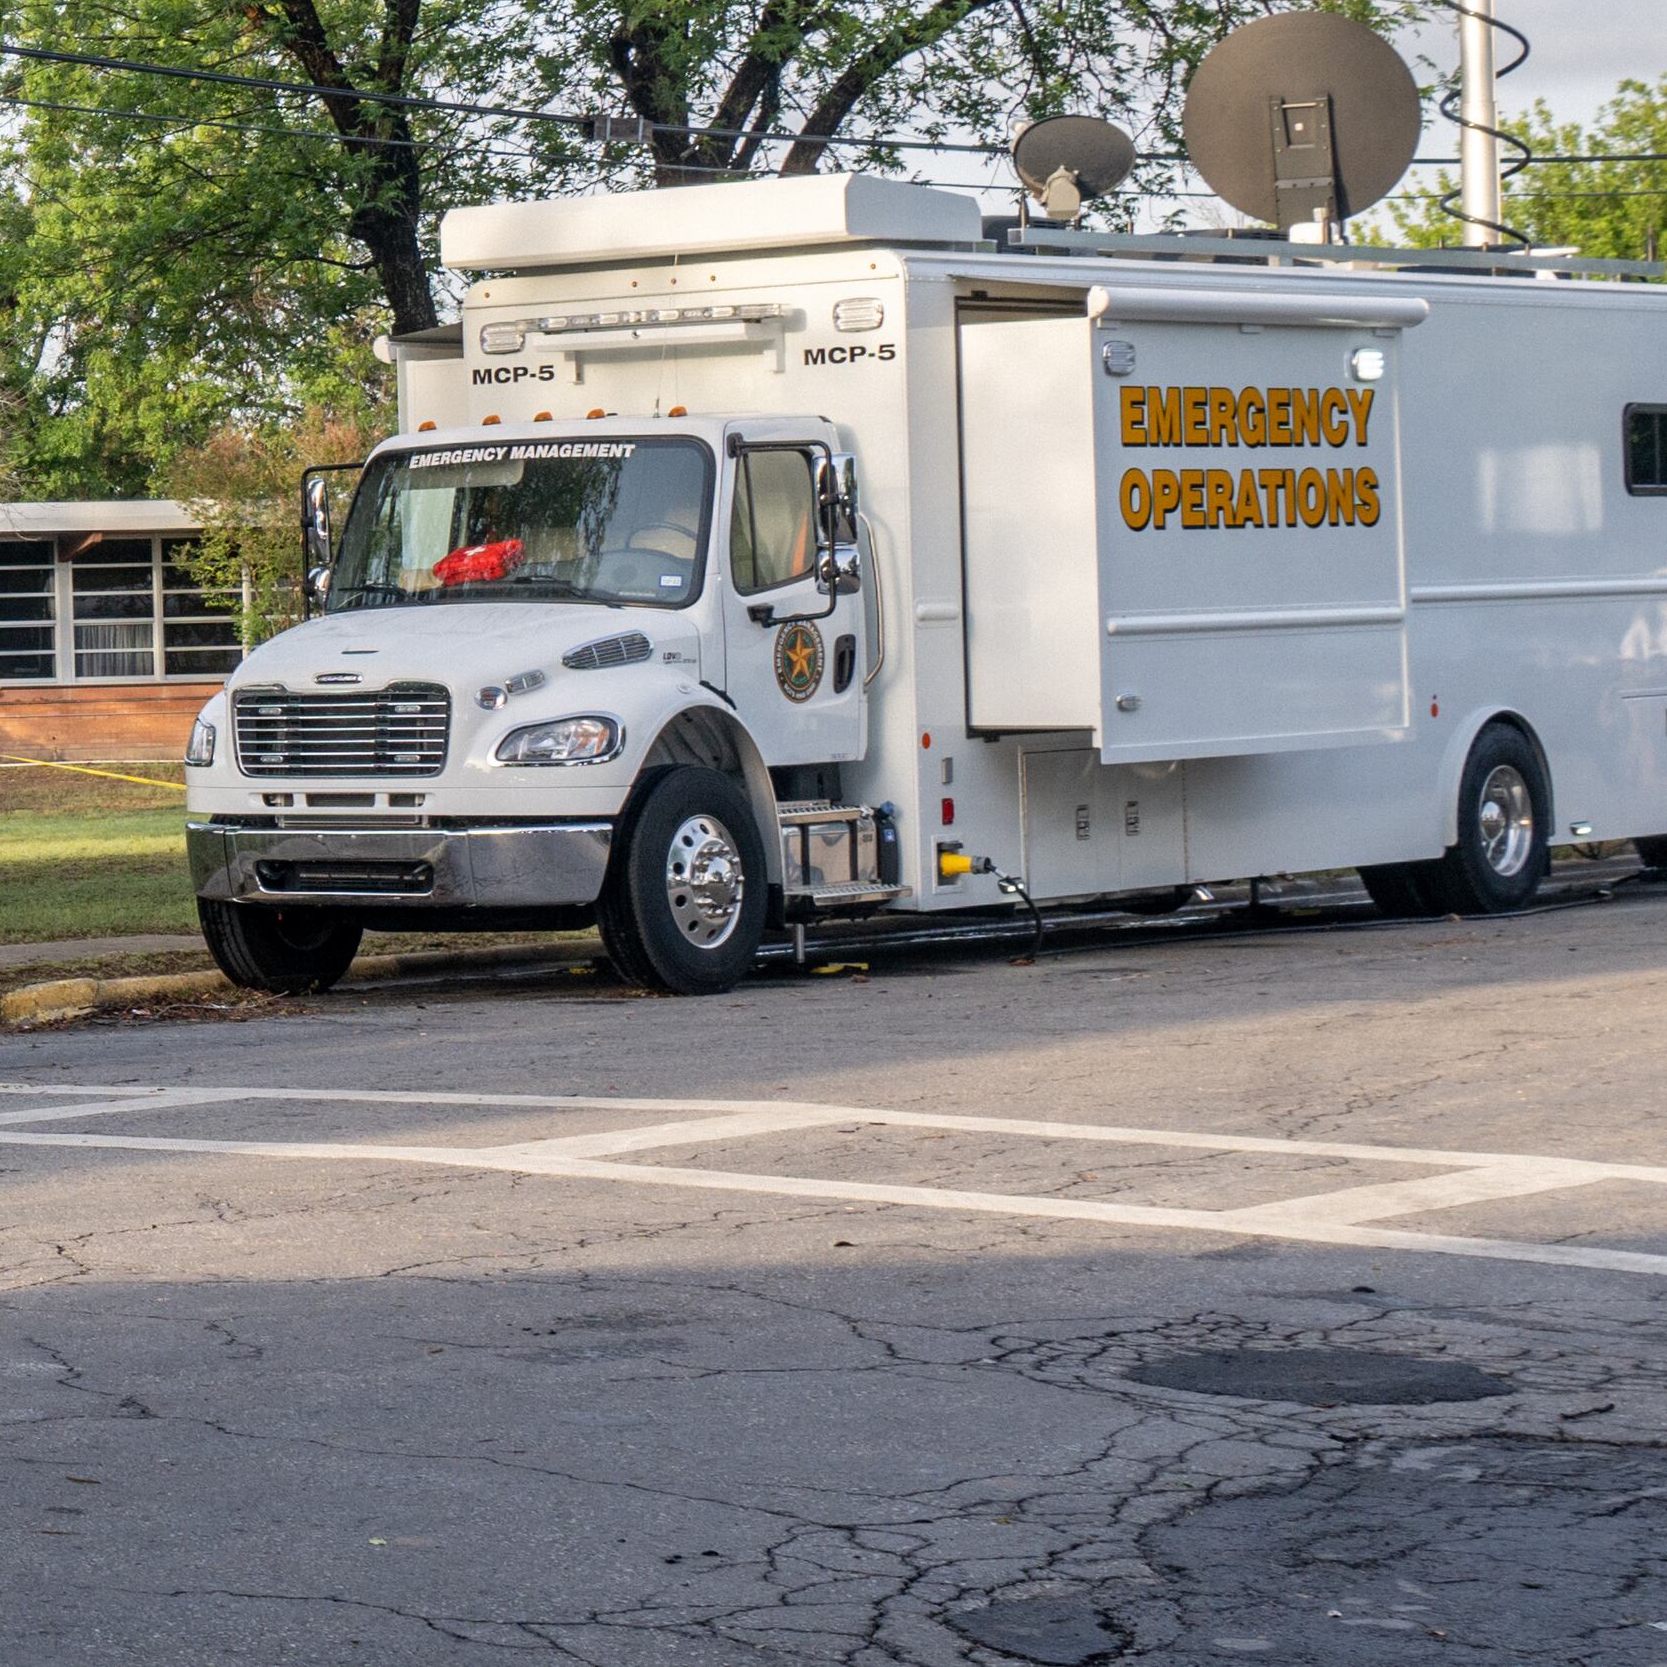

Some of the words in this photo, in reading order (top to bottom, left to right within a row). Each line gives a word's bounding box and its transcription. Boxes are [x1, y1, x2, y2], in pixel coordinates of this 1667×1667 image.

[804, 343, 896, 366] MCP-5
[472, 364, 555, 385] MCP-5
[1119, 385, 1375, 448] EMERGENCY
[409, 446, 509, 469] EMERGENCY
[510, 443, 636, 460] MANAGEMENT
[1119, 466, 1381, 532] OPERATIONS
